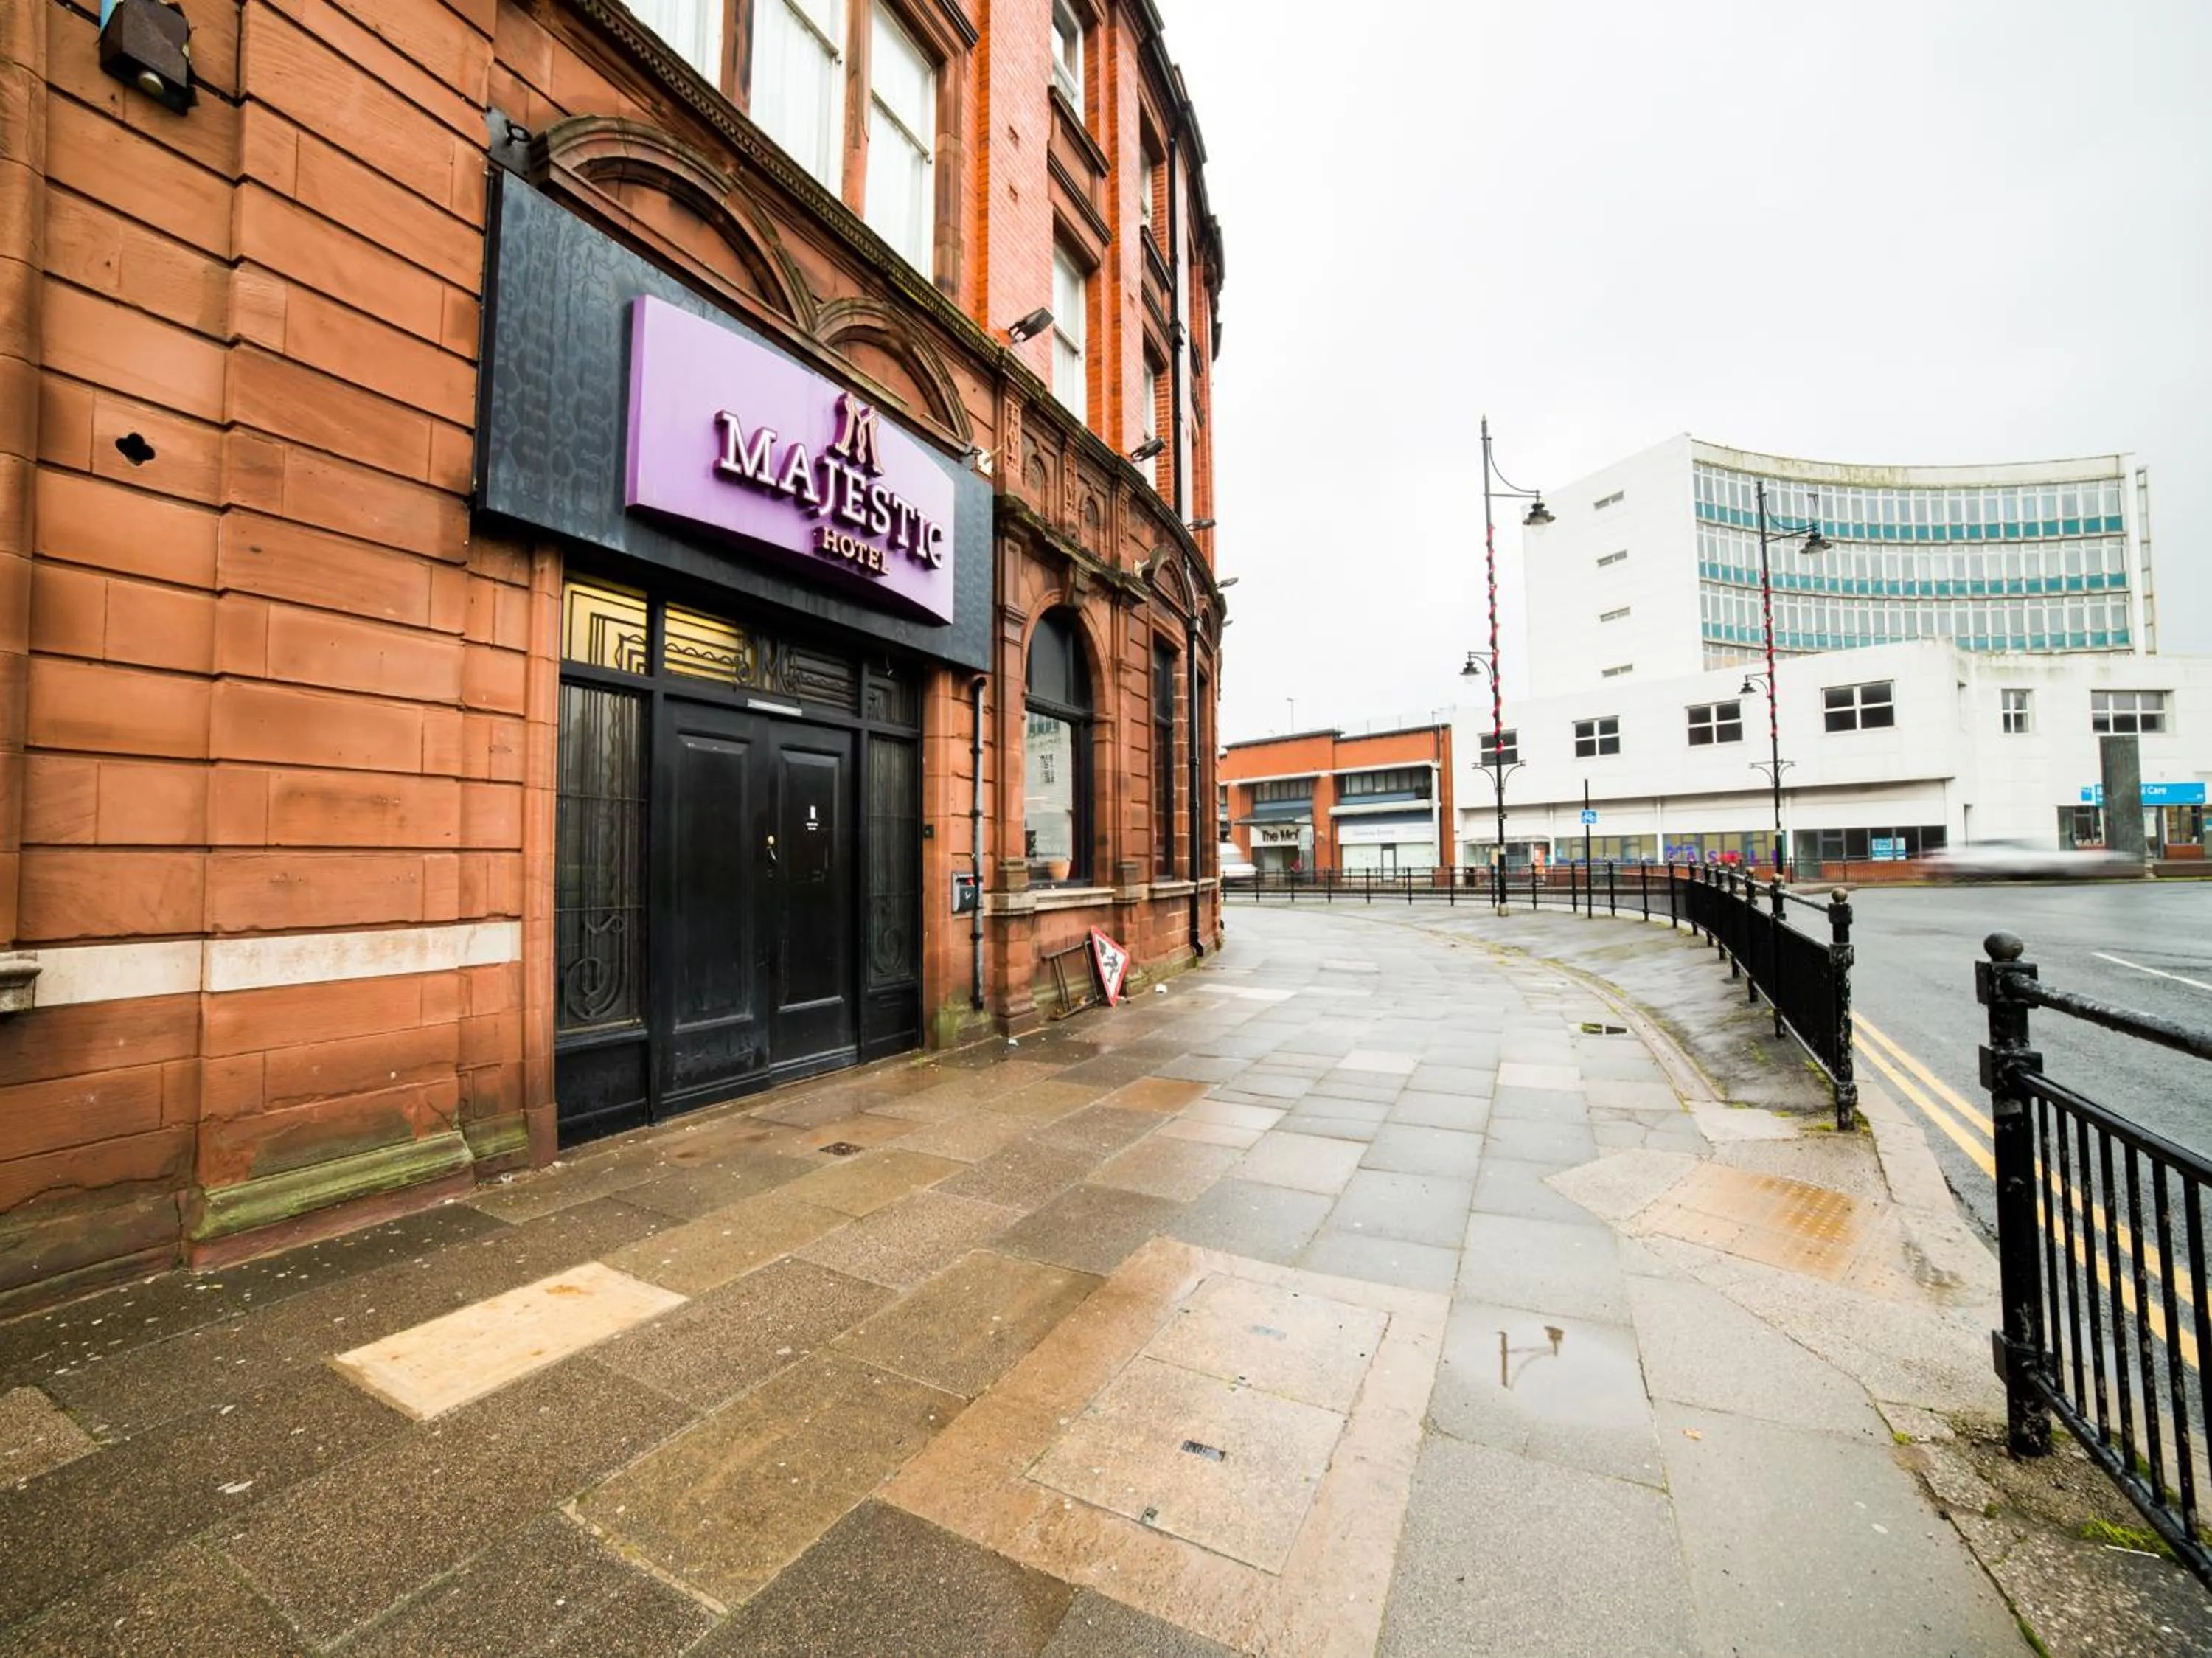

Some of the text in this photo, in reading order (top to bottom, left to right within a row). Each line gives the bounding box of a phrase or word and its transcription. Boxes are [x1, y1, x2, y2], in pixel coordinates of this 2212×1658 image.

[714, 410, 944, 569] MAJESTIC
[818, 525, 891, 575] HOTEL
[2146, 785, 2168, 795] Care
